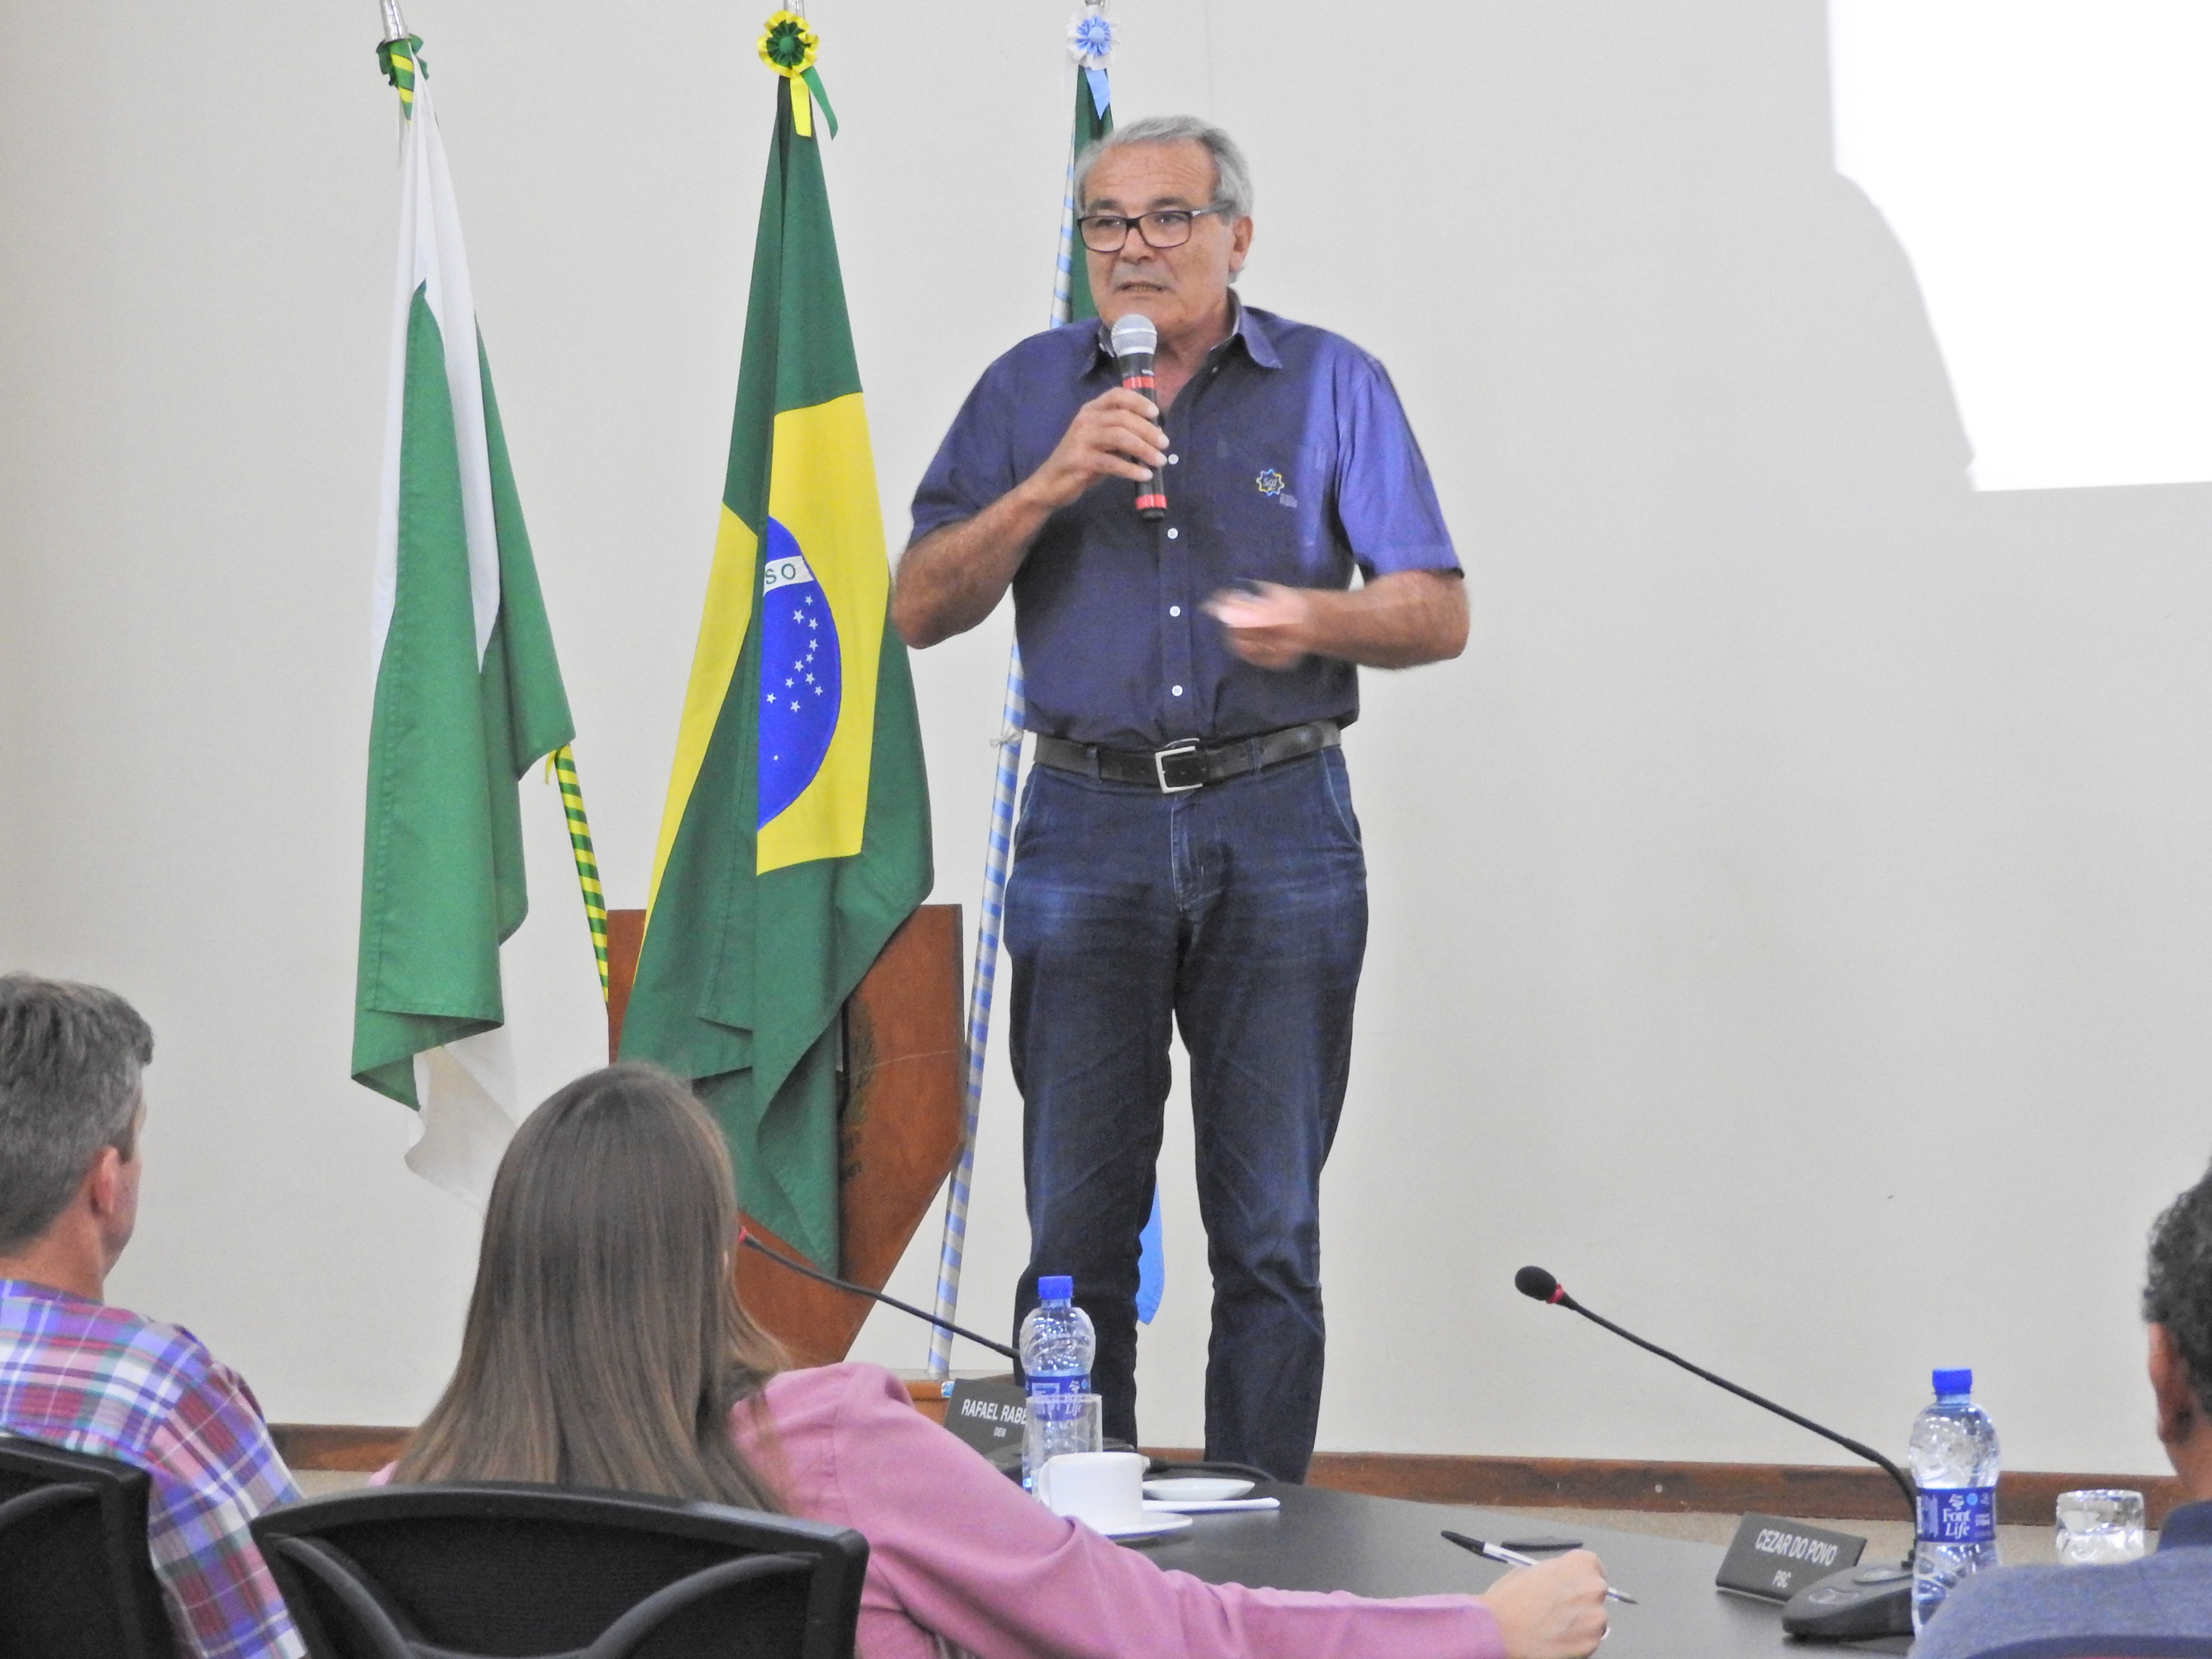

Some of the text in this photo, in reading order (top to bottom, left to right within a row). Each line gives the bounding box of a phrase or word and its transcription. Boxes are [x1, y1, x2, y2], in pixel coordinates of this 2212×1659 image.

[766, 563, 796, 584] SO
[961, 1398, 998, 1421] RAFAEL
[1943, 1508, 1971, 1522] Font
[1945, 1522, 1970, 1540] Life
[1755, 1529, 1838, 1566] CEZAR DO POVO
[1772, 1570, 1792, 1588] PSC
